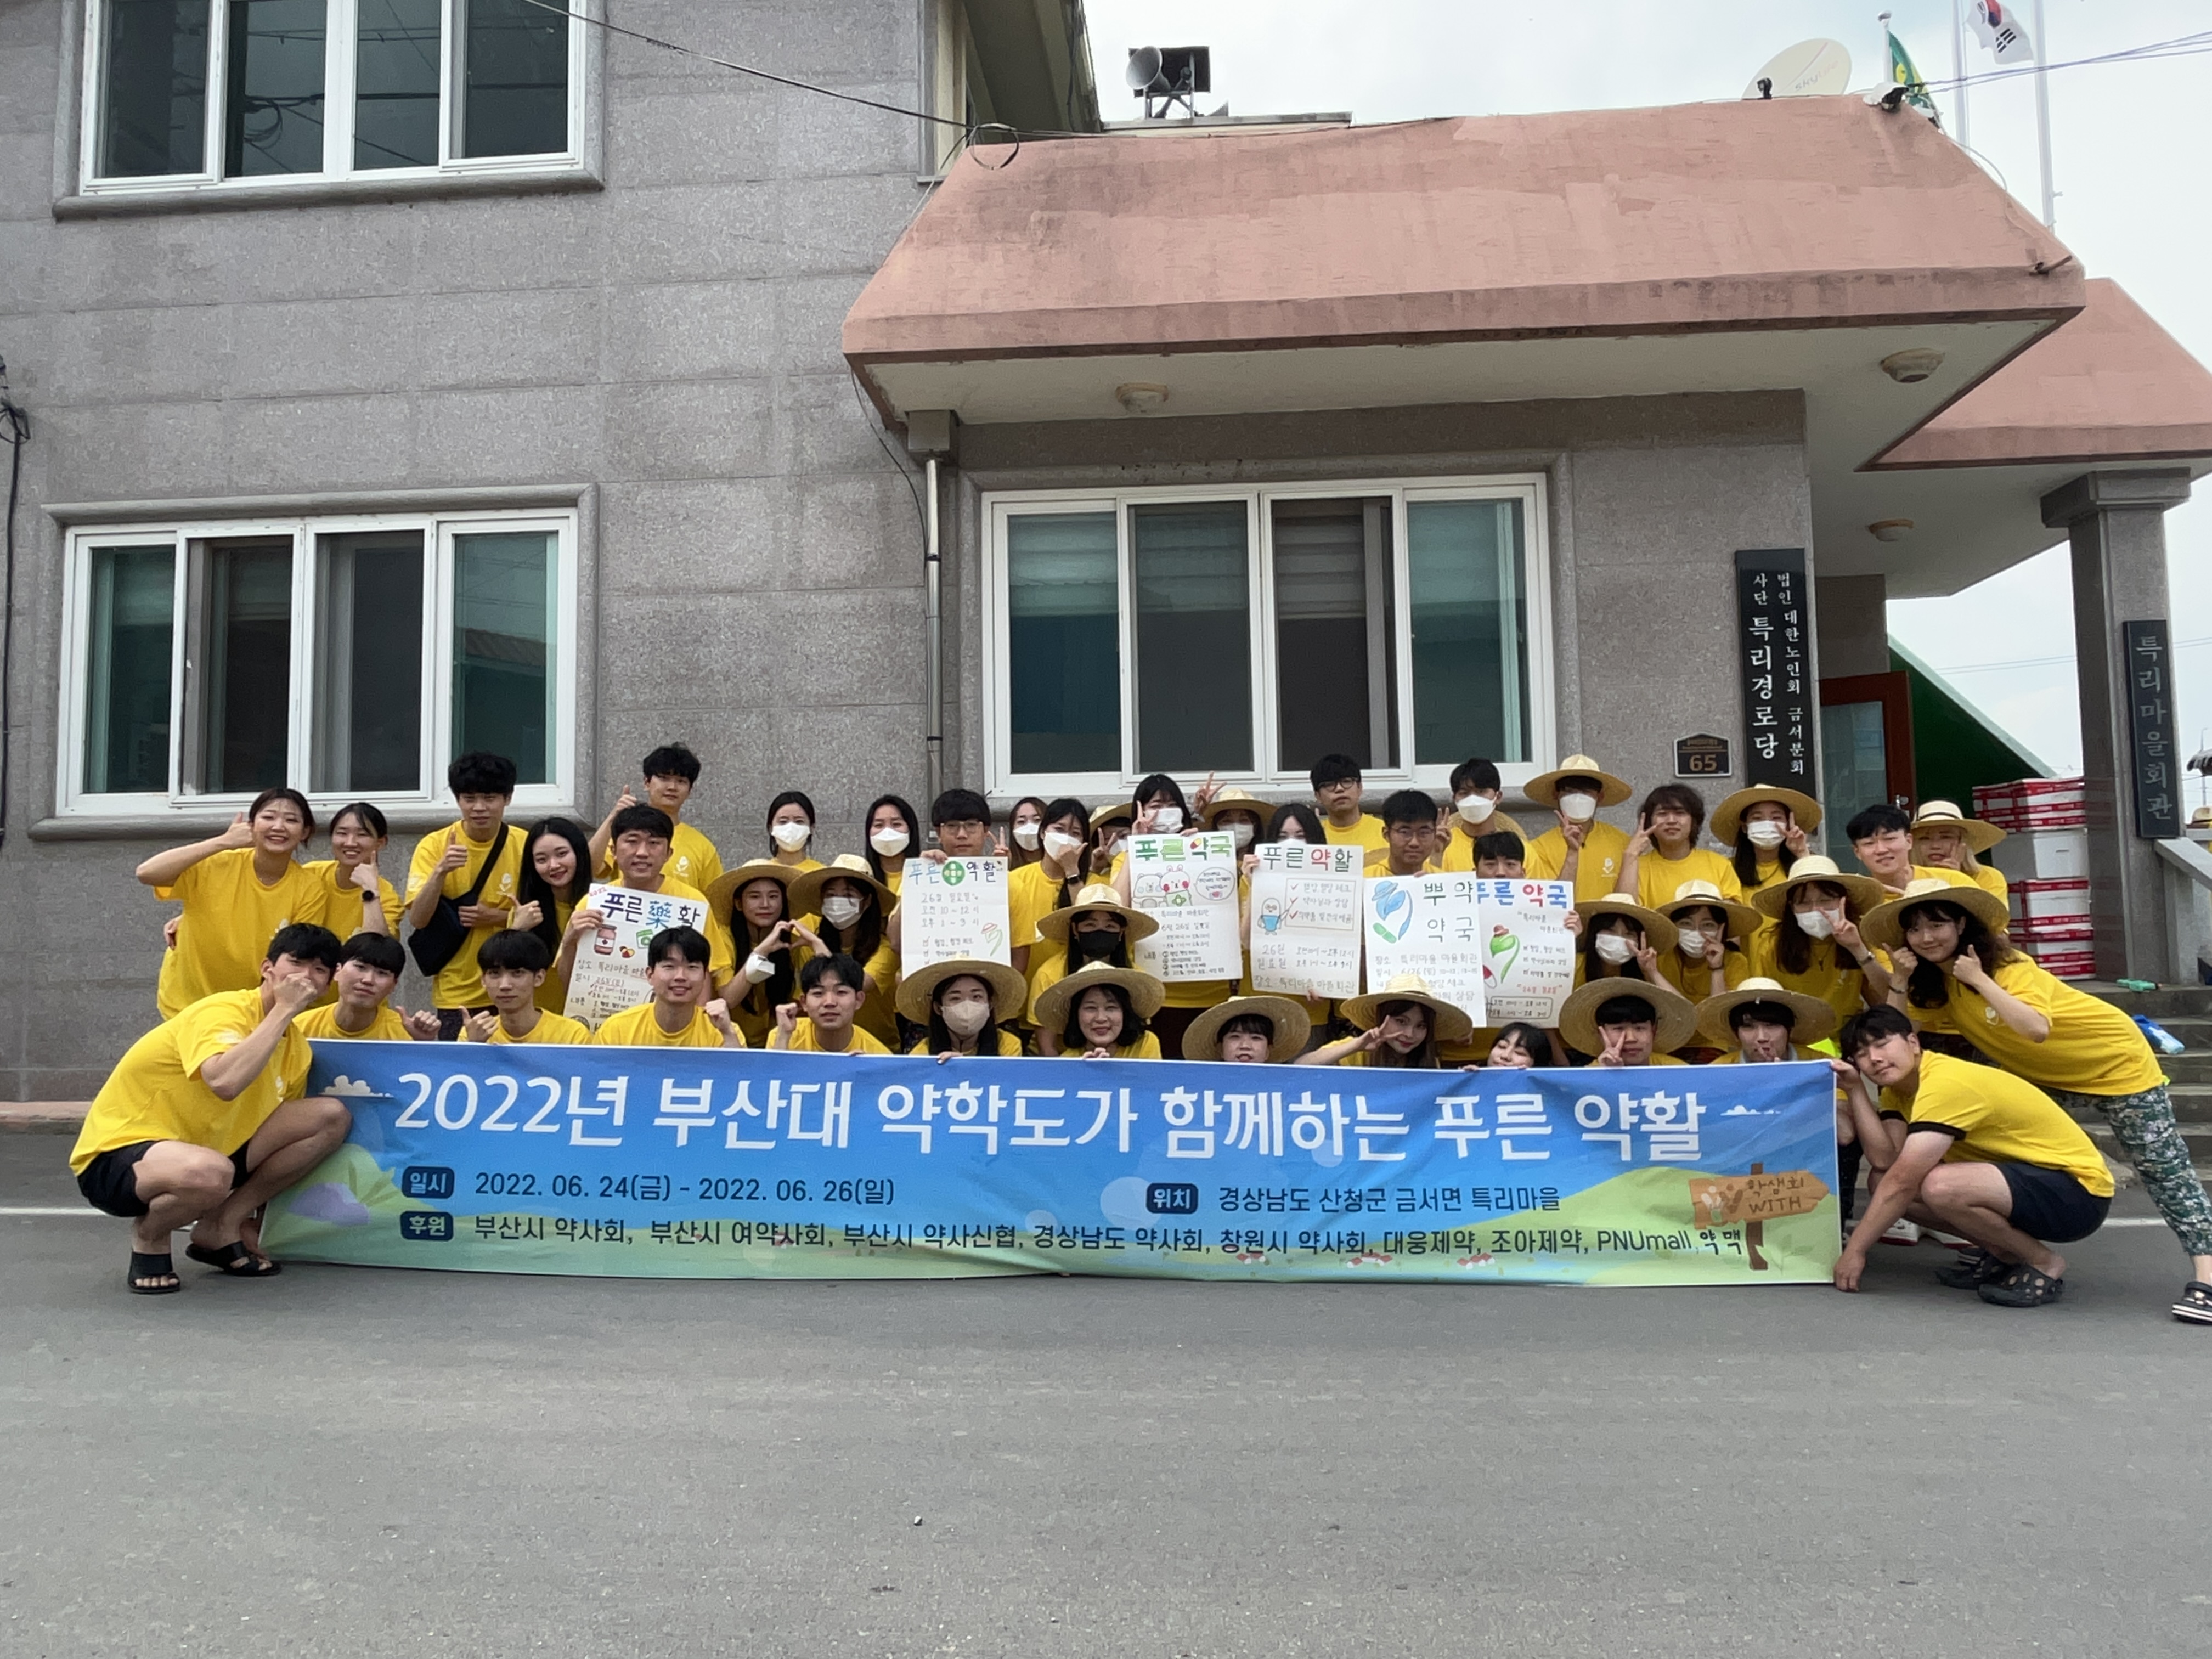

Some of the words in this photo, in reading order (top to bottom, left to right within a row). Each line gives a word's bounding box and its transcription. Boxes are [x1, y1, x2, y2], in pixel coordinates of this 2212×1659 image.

[1784, 610, 1801, 695] 대한노인회
[1748, 617, 1779, 759] 특리경로당
[2135, 635, 2173, 821] 특리마을회관
[1788, 707, 1804, 775] 금서분회
[1689, 754, 1717, 772] 65
[1135, 838, 1186, 861] 푸른
[1263, 847, 1304, 870] 푸른
[1311, 848, 1353, 872] 약활
[909, 862, 941, 885] 푸른
[966, 860, 996, 883] 약활
[600, 893, 643, 923] 푸른
[1522, 884, 1567, 909] 약국
[1427, 917, 1474, 943] 약국
[394, 1073, 629, 1147] 2022년
[653, 1078, 853, 1150] 부산대
[878, 1080, 1138, 1155] 약학도가
[1160, 1085, 1410, 1161] 함께하는
[1434, 1093, 1553, 1161] 푸른
[1574, 1090, 1707, 1161] 약활
[409, 1172, 448, 1195] 일시
[475, 1173, 543, 1198] 2022.
[552, 1174, 590, 1198] 06.
[600, 1175, 671, 1201] 24(금)
[699, 1178, 767, 1201] 2022.
[776, 1180, 814, 1202] 06.
[823, 1178, 895, 1205] 26(일)
[1746, 1176, 1804, 1196] 학생회
[1153, 1188, 1192, 1209] 위치
[1219, 1187, 1310, 1212] 경상남도
[1319, 1188, 1387, 1212] 산청군
[1396, 1187, 1462, 1212] 금서면
[1471, 1187, 1560, 1211] 특리마을
[1749, 1197, 1801, 1214] WITH
[409, 1216, 447, 1234] 후원
[475, 1216, 544, 1241] 부산시
[555, 1218, 634, 1245] 약사회,
[651, 1221, 720, 1245] 부산시
[732, 1221, 833, 1248] 여약사회,
[844, 1223, 912, 1248] 부산시
[924, 1224, 1023, 1249] 약사신협,
[1034, 1224, 1126, 1250] 경상남도
[1135, 1228, 1210, 1254] 약사회,
[1221, 1228, 1288, 1254] 창원시
[1299, 1229, 1373, 1255] 약사회,
[1384, 1229, 1481, 1255] 대웅제약,
[1491, 1228, 1588, 1255] 조아제약,
